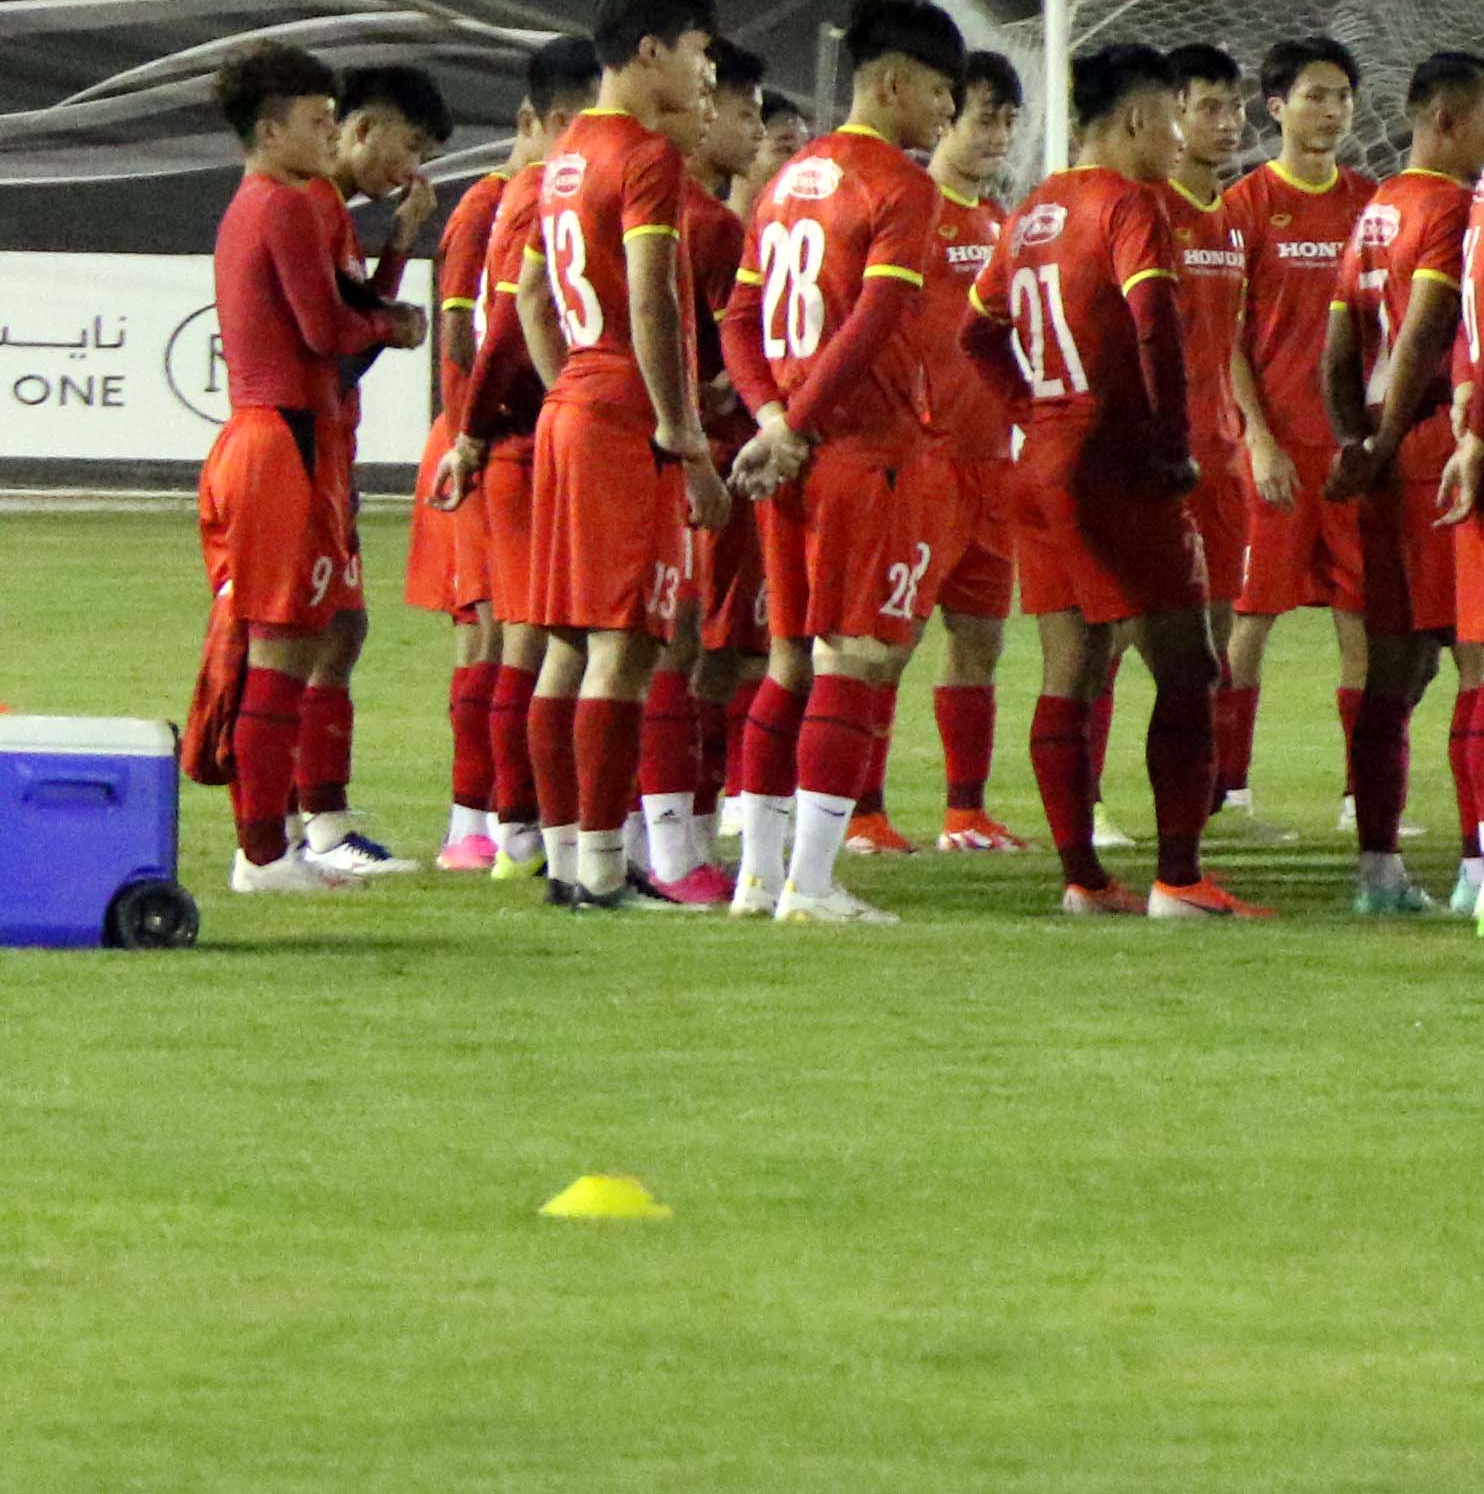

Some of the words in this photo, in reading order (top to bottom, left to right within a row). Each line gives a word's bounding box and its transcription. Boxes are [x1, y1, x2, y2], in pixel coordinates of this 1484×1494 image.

[542, 208, 605, 349] 13
[760, 217, 826, 360] 28
[1009, 263, 1090, 399] 21
[13, 374, 126, 407] ONE
